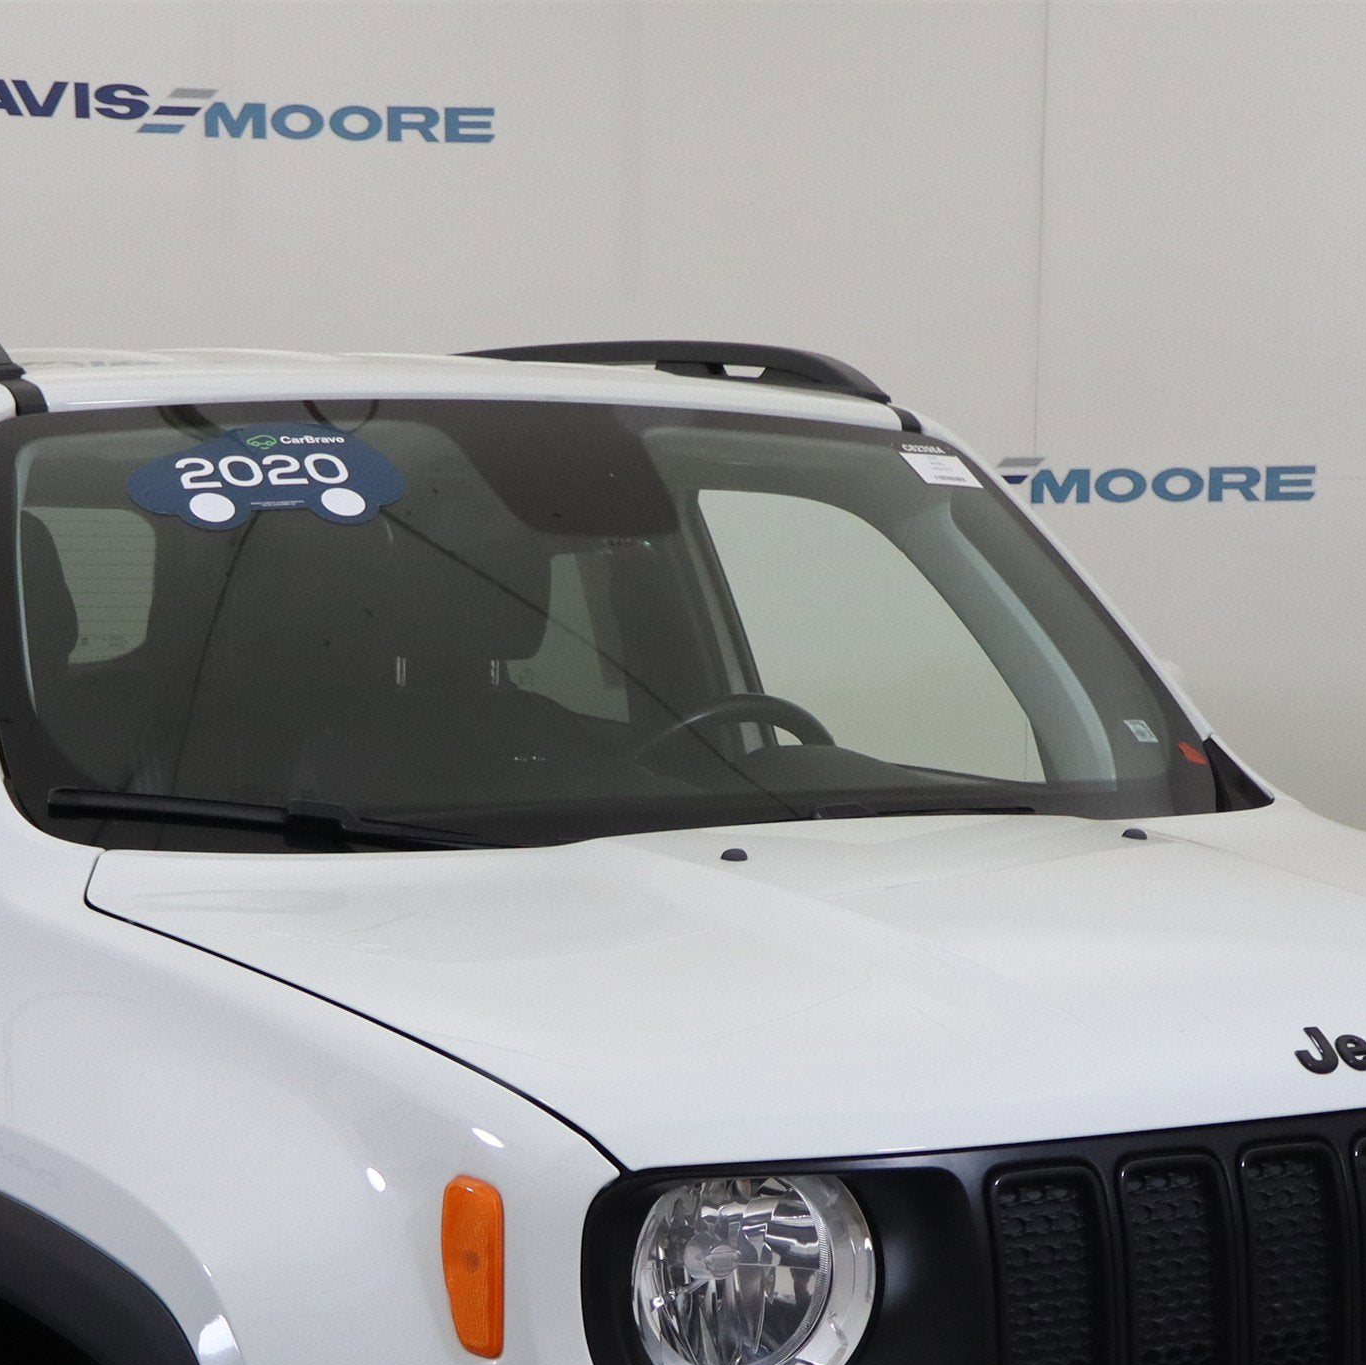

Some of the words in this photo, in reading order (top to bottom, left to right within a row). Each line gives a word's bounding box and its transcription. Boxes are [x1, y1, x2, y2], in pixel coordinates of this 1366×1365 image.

[204, 101, 496, 144] MOORE
[279, 435, 345, 445] CarBravo
[174, 452, 349, 490] 2020
[1029, 465, 1317, 505] MOORE
